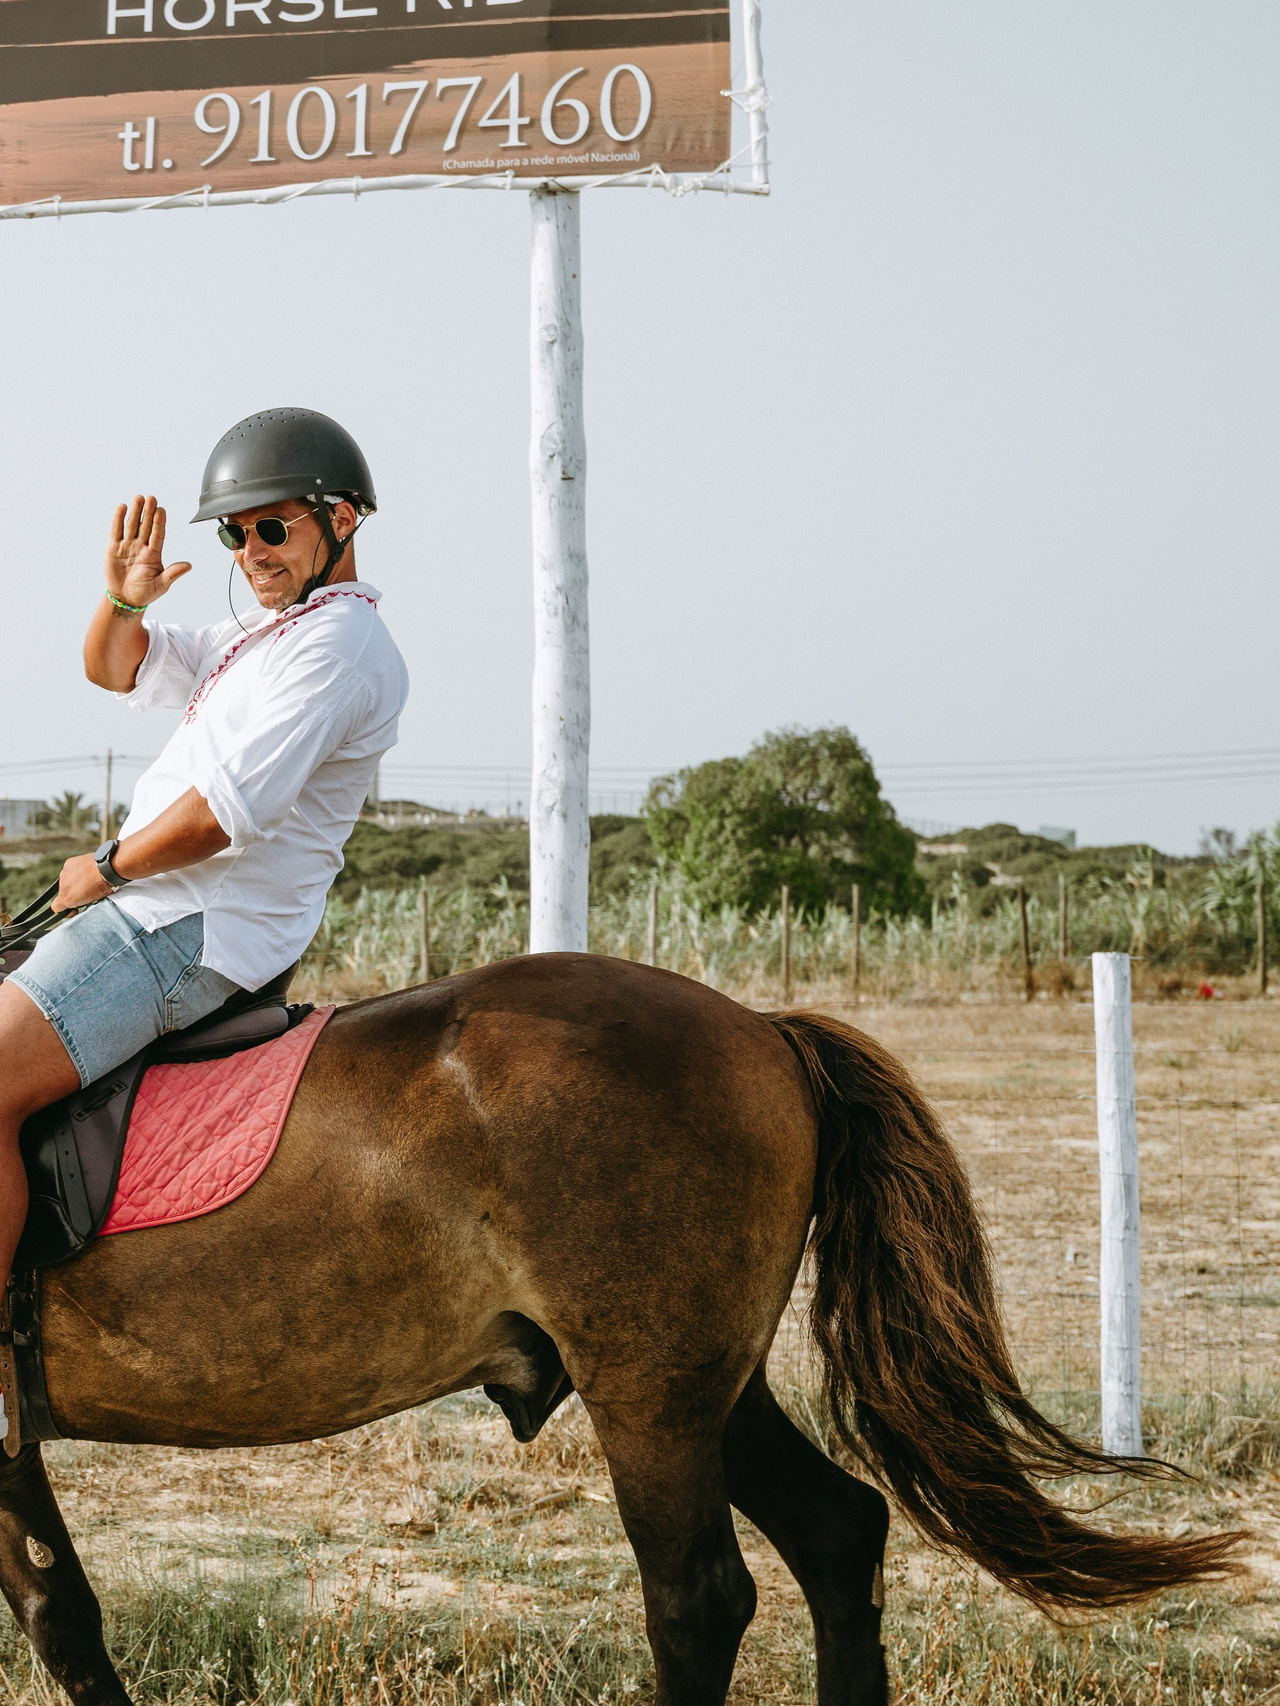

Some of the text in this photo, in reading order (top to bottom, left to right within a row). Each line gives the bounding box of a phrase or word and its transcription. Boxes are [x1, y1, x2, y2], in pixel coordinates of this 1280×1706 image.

[118, 64, 652, 171] tl. 910177460
[442, 150, 640, 171] (Chamada para a rede móvel Nacional)
